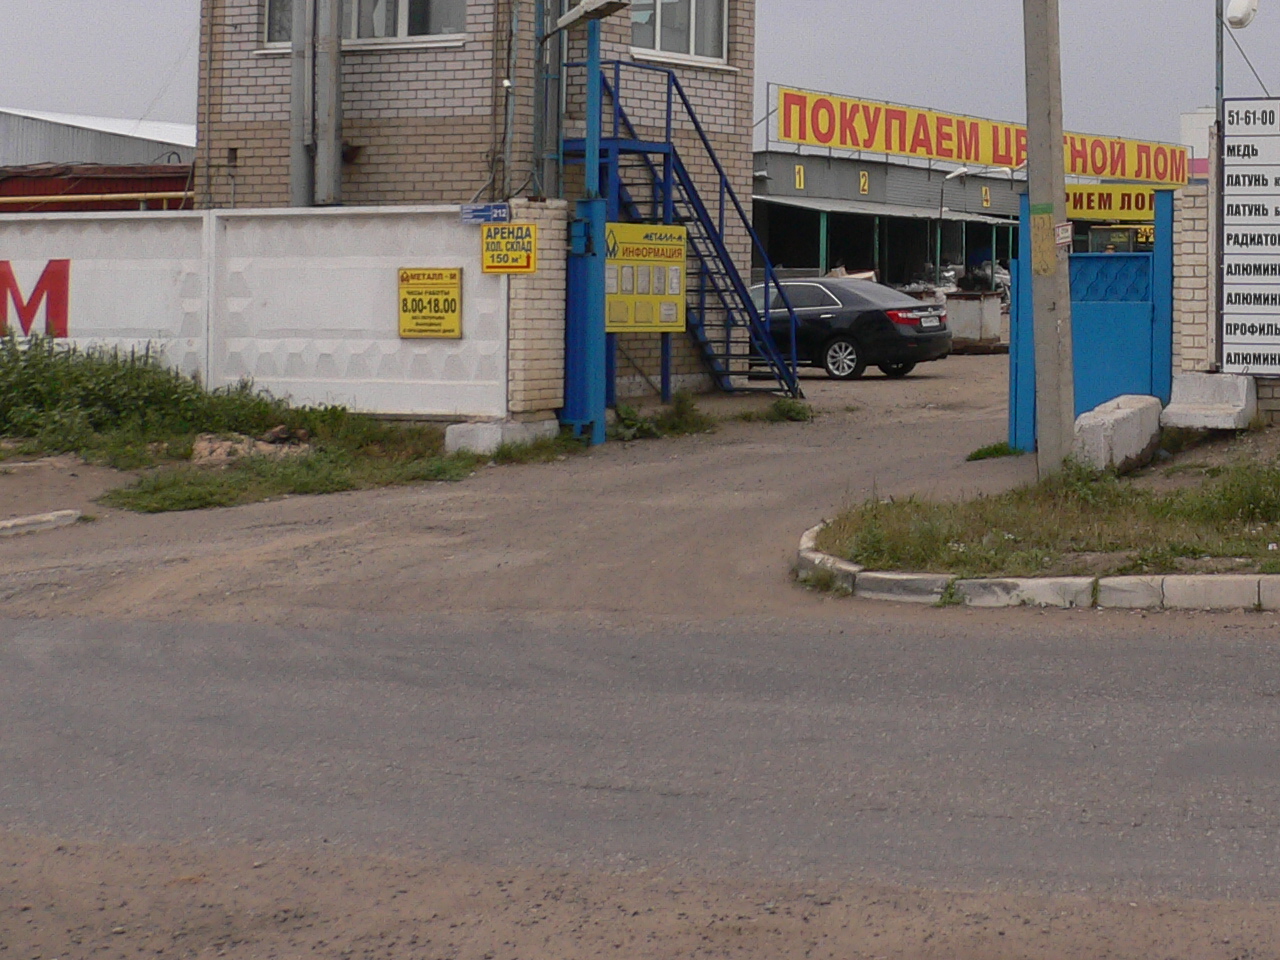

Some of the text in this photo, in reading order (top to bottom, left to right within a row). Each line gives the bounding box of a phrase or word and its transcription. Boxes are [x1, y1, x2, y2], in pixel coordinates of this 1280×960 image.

[1228, 110, 1275, 126] 51-61-00
[783, 92, 1186, 183] ПОКУПАЕМ ЦВНОЙ ЛОМ
[1227, 144, 1258, 158] МЕДЬ
[860, 173, 867, 193] 2
[1226, 174, 1268, 186] ЛАТУНЬ
[1226, 204, 1268, 217] ЛАТУНЬ
[486, 227, 532, 240] АРЕНДА
[505, 240, 532, 253] СКЛАД
[622, 246, 683, 259] ИНФОРМАЦИЯ
[490, 253, 509, 263] 150
[402, 298, 457, 313] 8.00-18.00
